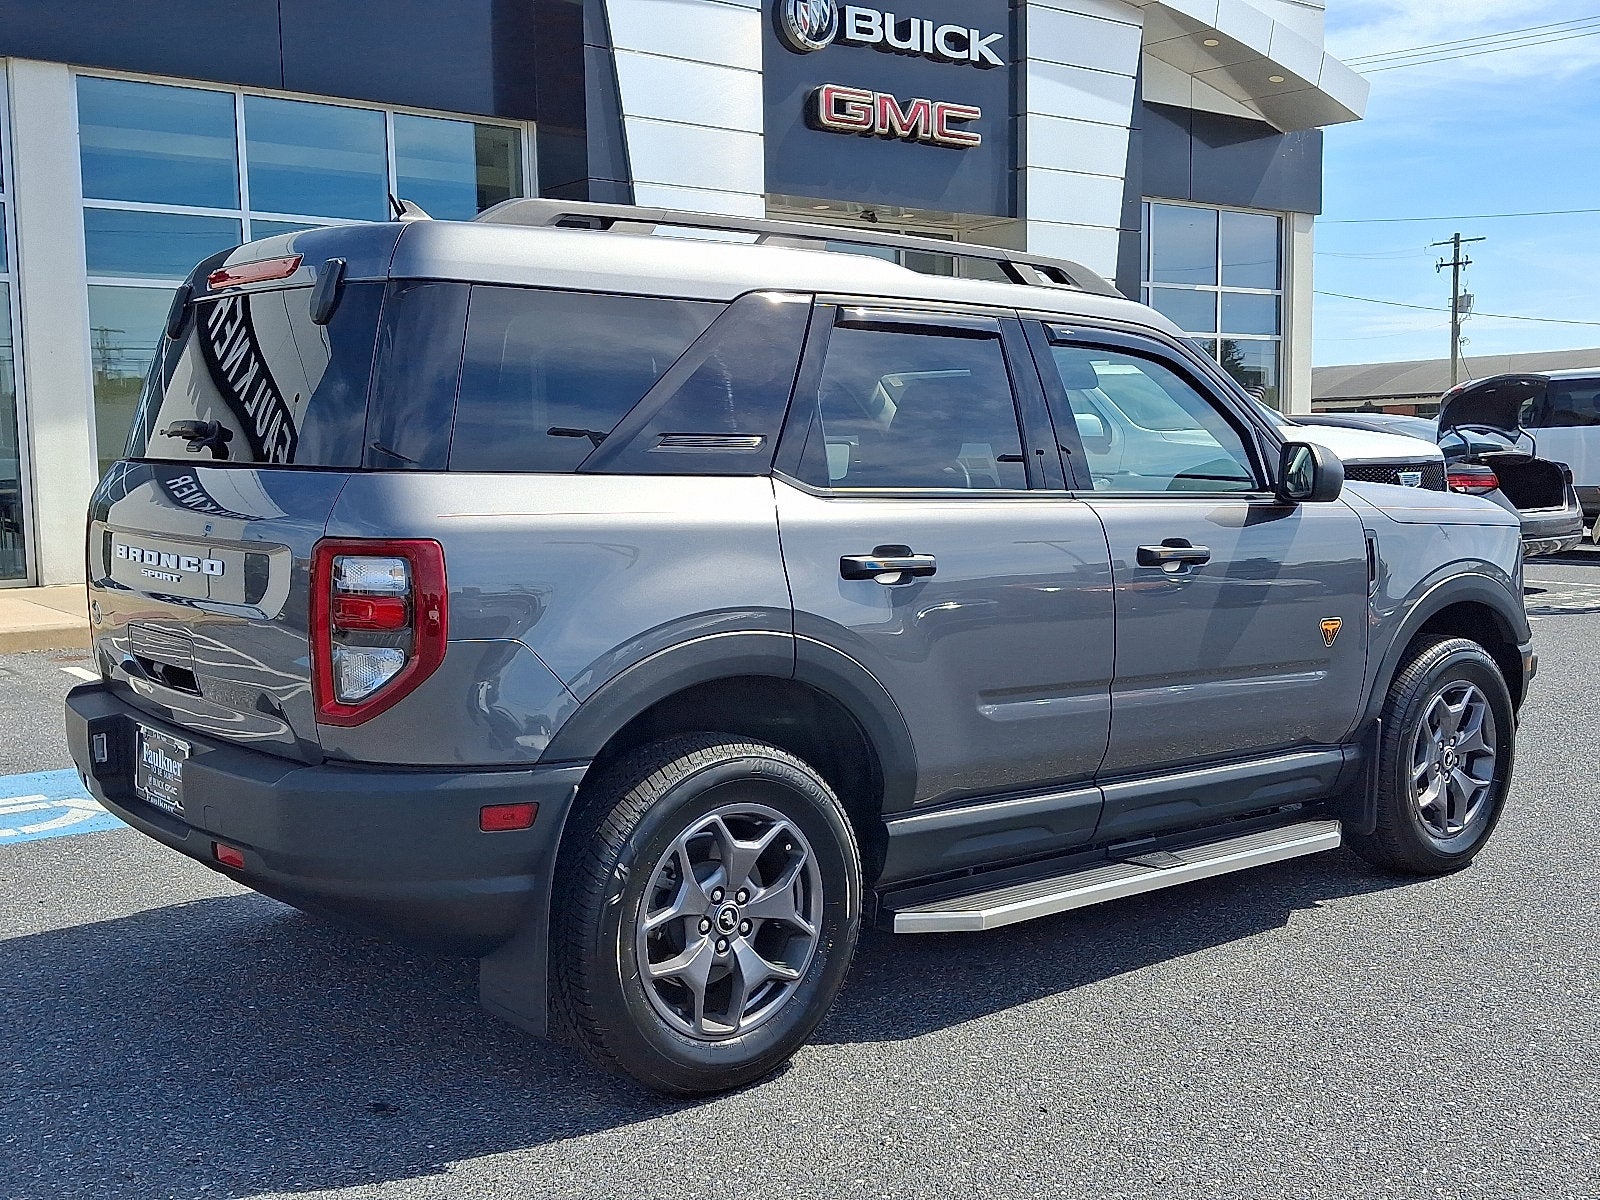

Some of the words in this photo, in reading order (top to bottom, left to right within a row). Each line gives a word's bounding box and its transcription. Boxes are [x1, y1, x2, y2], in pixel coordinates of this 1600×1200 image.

[845, 5, 1004, 66] BUICK
[819, 84, 982, 148] GMC
[116, 544, 225, 576] BRONCO
[141, 568, 183, 583] SPORT
[142, 741, 183, 777] Faulkner
[146, 793, 175, 813] Faulkner
